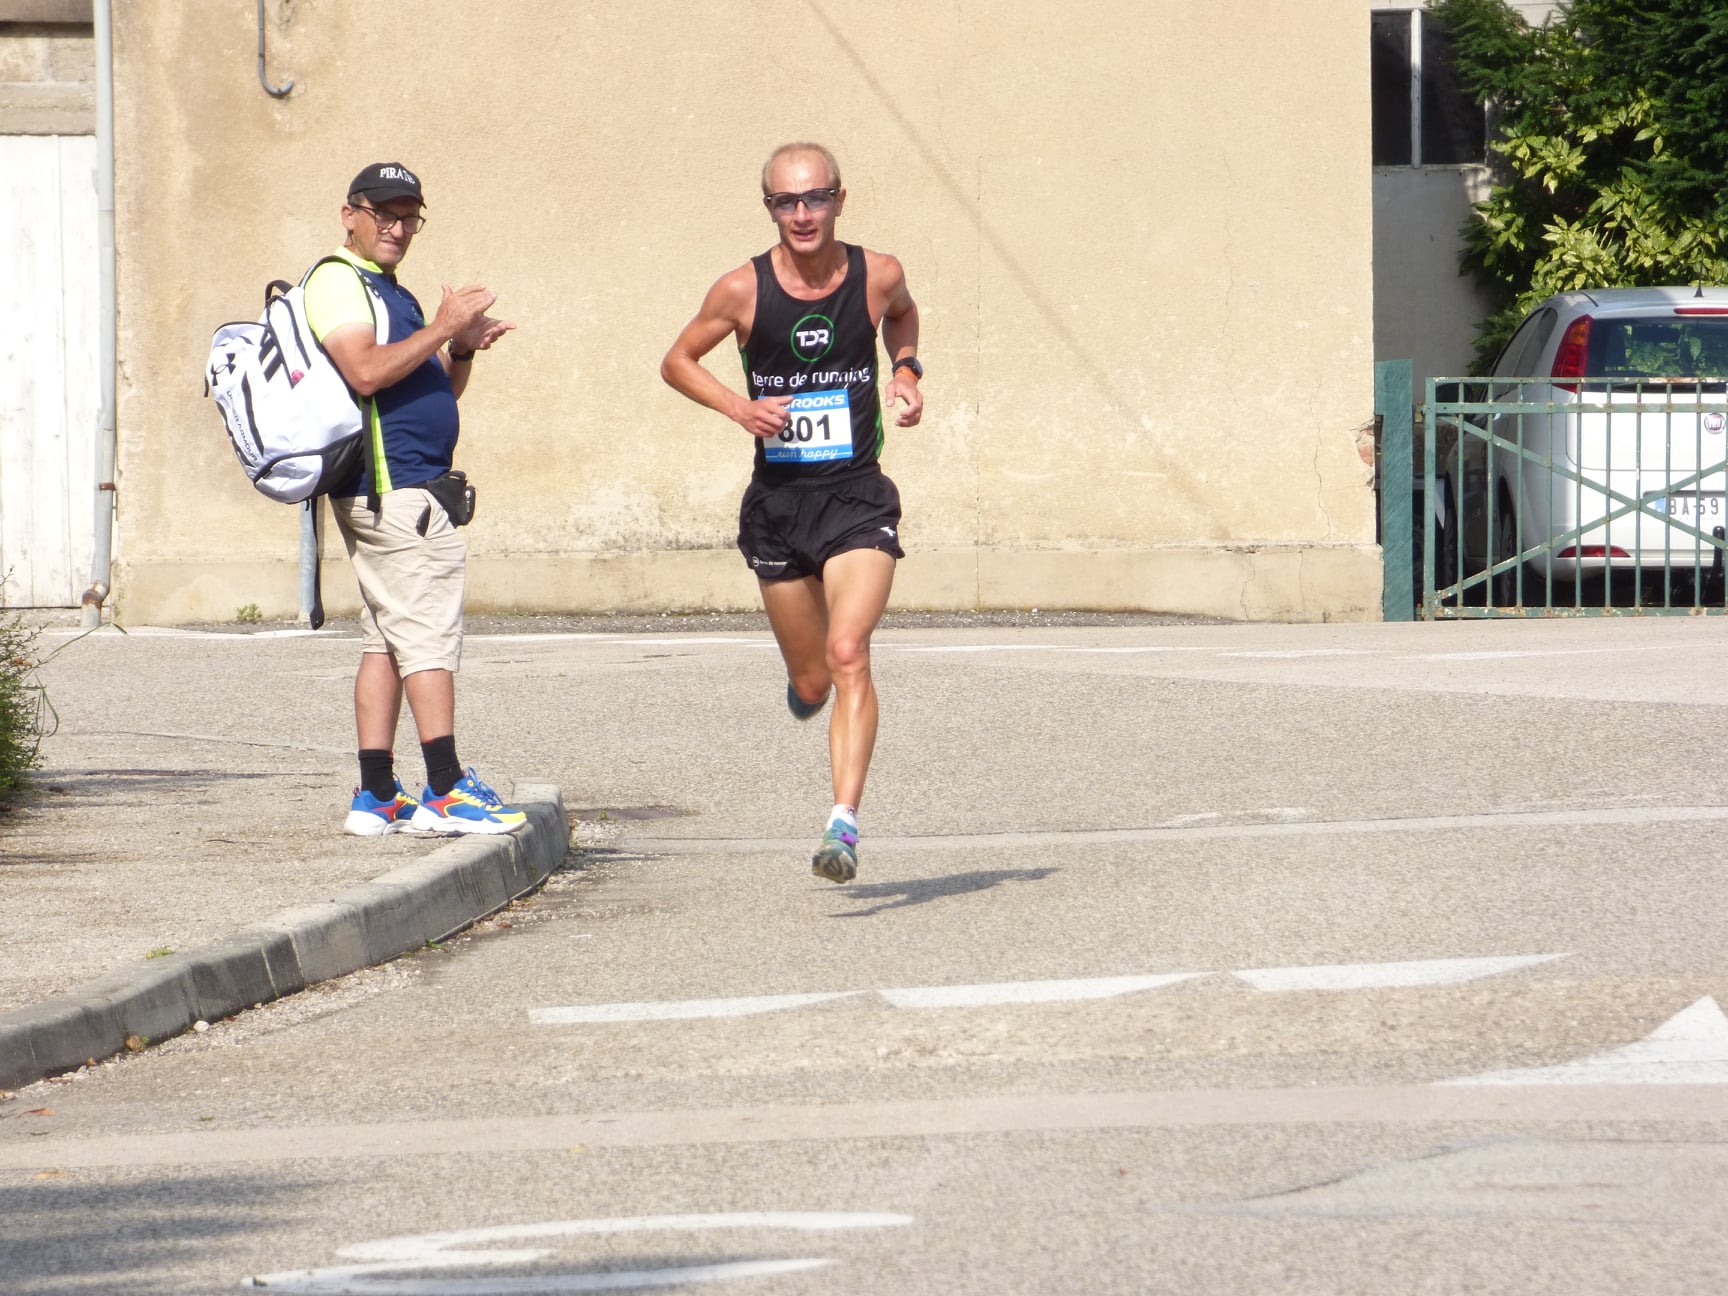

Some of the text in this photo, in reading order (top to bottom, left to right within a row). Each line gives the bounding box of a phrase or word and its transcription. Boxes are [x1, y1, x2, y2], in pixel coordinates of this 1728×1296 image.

[379, 167, 415, 184] PIRATE
[796, 328, 829, 347] TDR
[752, 367, 871, 387] terre de running
[783, 394, 845, 409] ROOKS
[778, 413, 831, 442] 801
[776, 447, 839, 461] run happy
